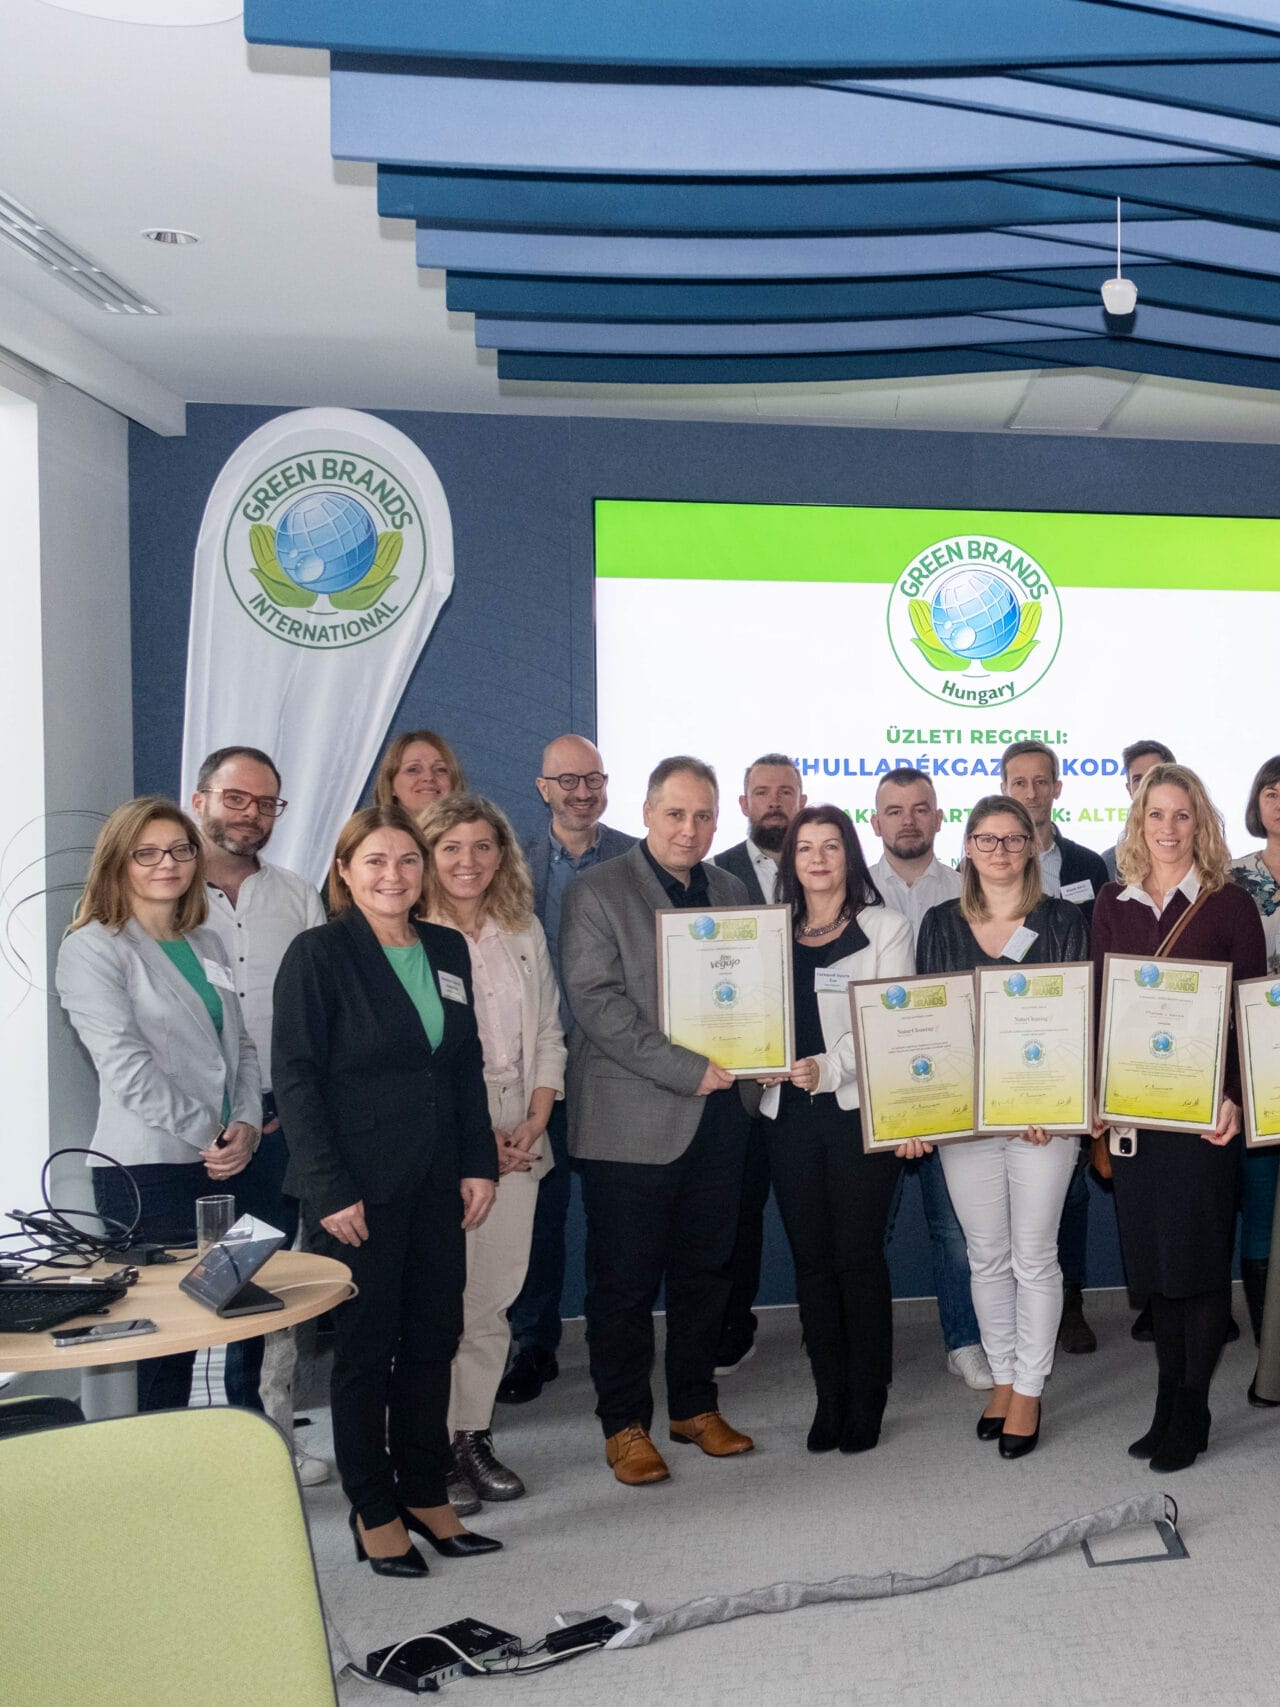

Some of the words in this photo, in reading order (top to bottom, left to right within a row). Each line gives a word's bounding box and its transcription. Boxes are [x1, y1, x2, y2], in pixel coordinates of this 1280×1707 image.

[242, 459, 317, 523] GREEN
[321, 457, 414, 530] BRANDS
[900, 541, 964, 598] GREEN
[967, 540, 1049, 600] BRANDS
[248, 592, 400, 643] INTERNATIONAL
[941, 680, 1016, 705] Hungary
[886, 725, 963, 745] ÜZLETI
[970, 729, 1068, 745] REGGELI:
